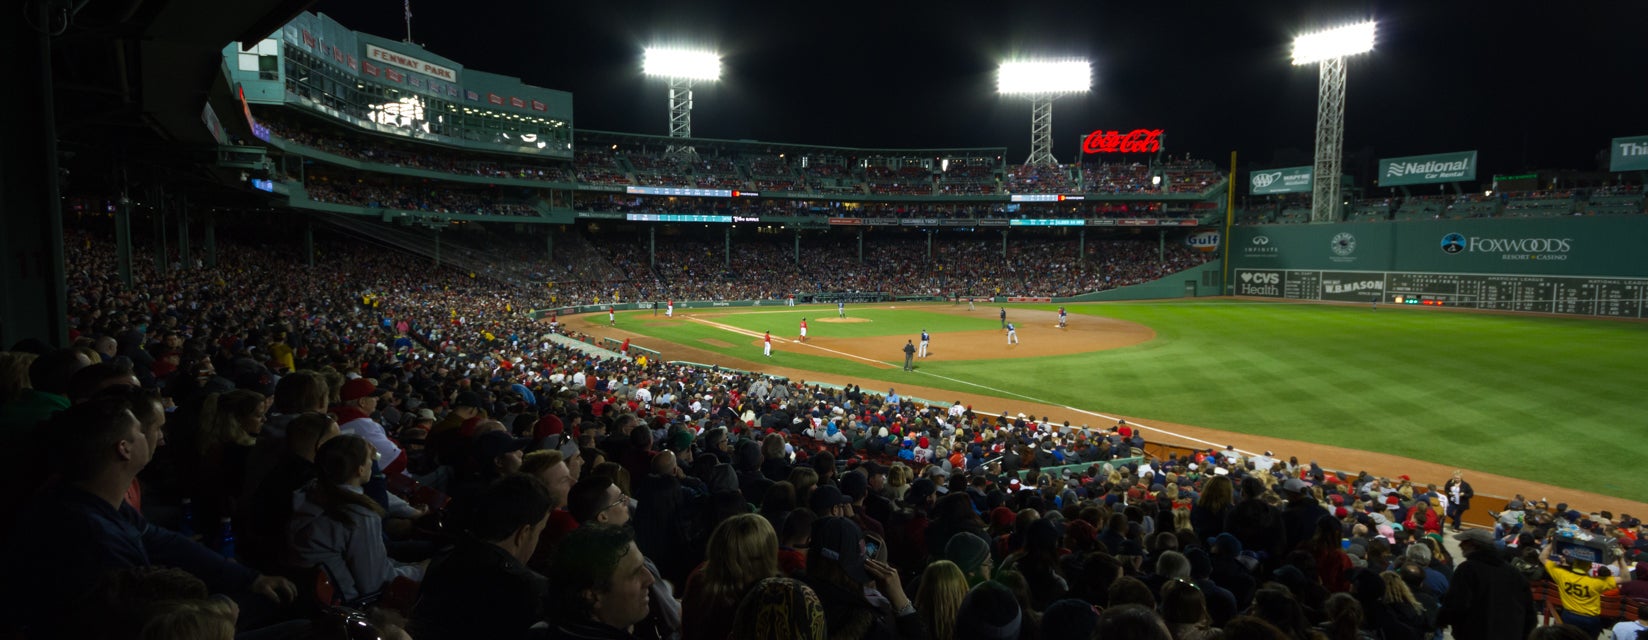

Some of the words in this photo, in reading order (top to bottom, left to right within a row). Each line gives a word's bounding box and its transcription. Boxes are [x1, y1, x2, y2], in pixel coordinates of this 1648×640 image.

[374, 50, 418, 68] FENWAY
[424, 64, 451, 79] PARK
[1083, 128, 1164, 154] Coca-Cola
[1405, 158, 1468, 174] National
[1439, 171, 1465, 179] Rental
[1188, 235, 1219, 245] Gulf
[1469, 237, 1571, 252] FOXWOODS
[1252, 272, 1280, 284] CVS
[1242, 283, 1279, 296] Health
[1564, 582, 1591, 597] 251
